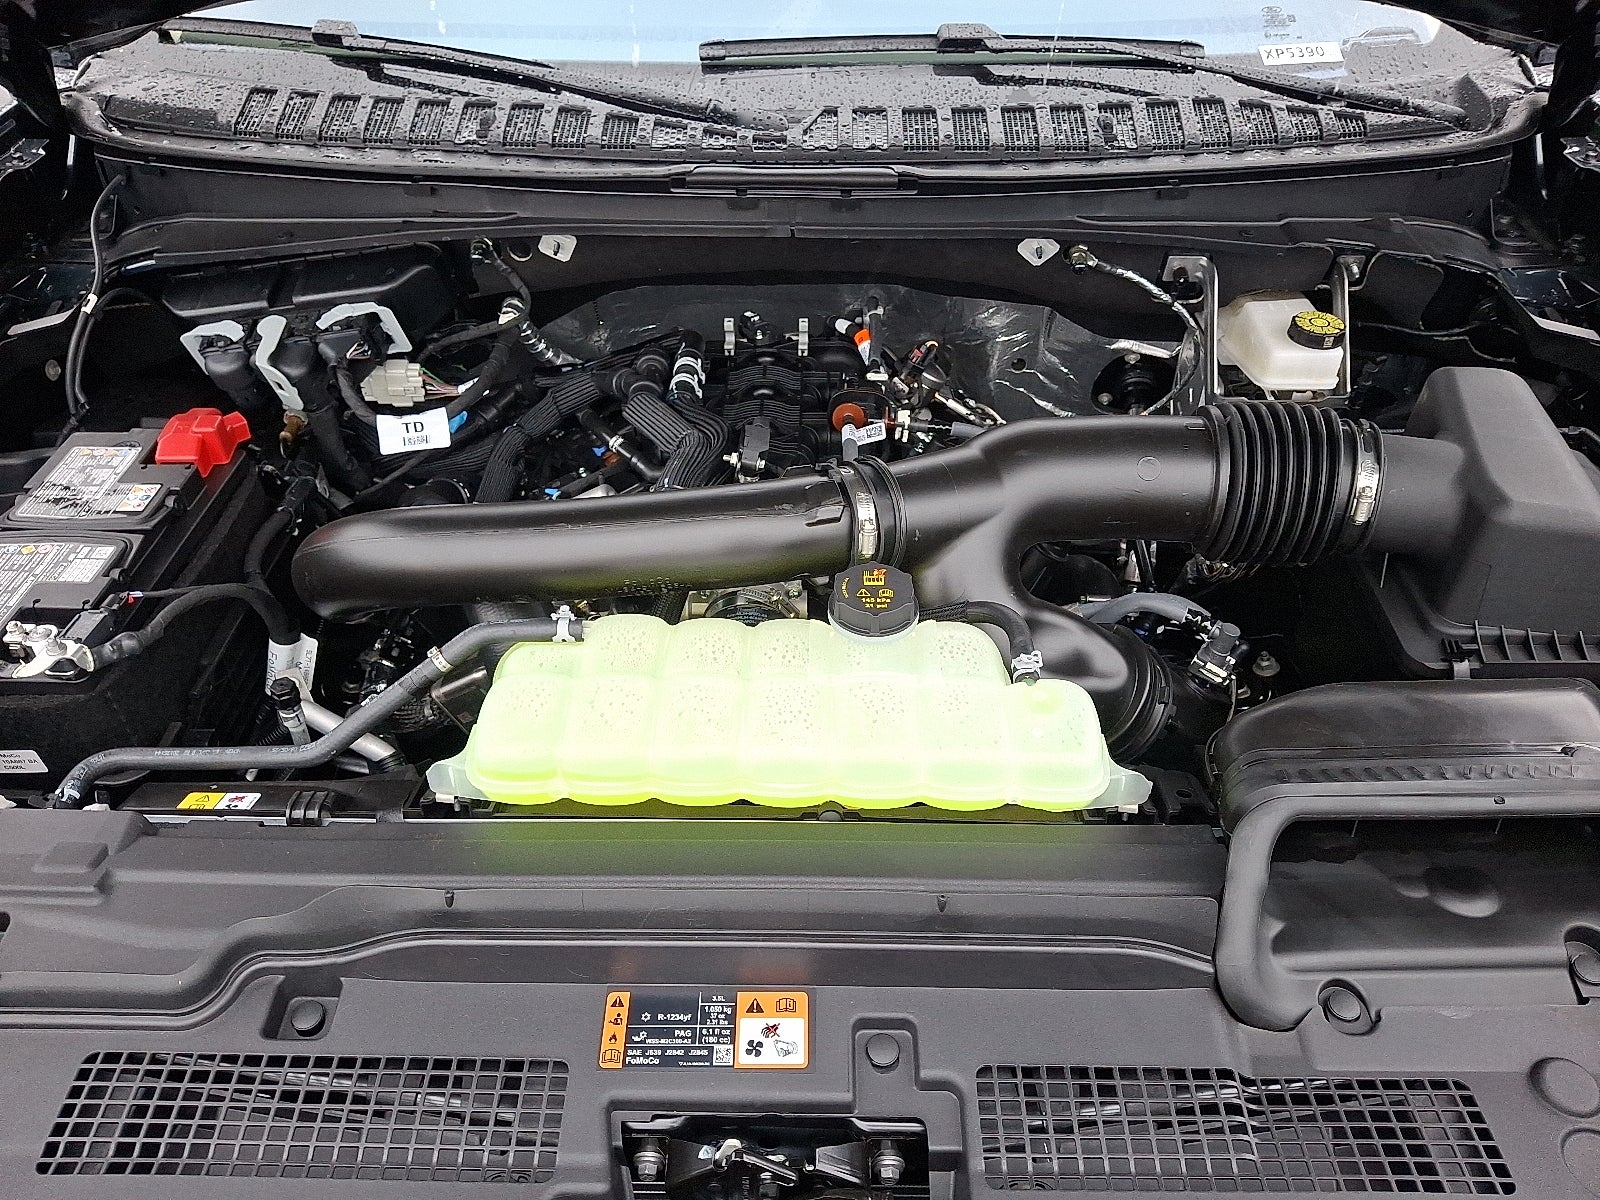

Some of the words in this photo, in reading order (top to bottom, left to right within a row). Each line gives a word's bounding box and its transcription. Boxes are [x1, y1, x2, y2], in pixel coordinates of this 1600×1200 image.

[1264, 46, 1325, 59] XP5390
[402, 421, 425, 434] TD
[723, 1006, 732, 1014] kg
[657, 1013, 692, 1022] R-1234yf
[674, 1029, 692, 1037] PAG
[626, 1056, 660, 1065] FoMoCo
